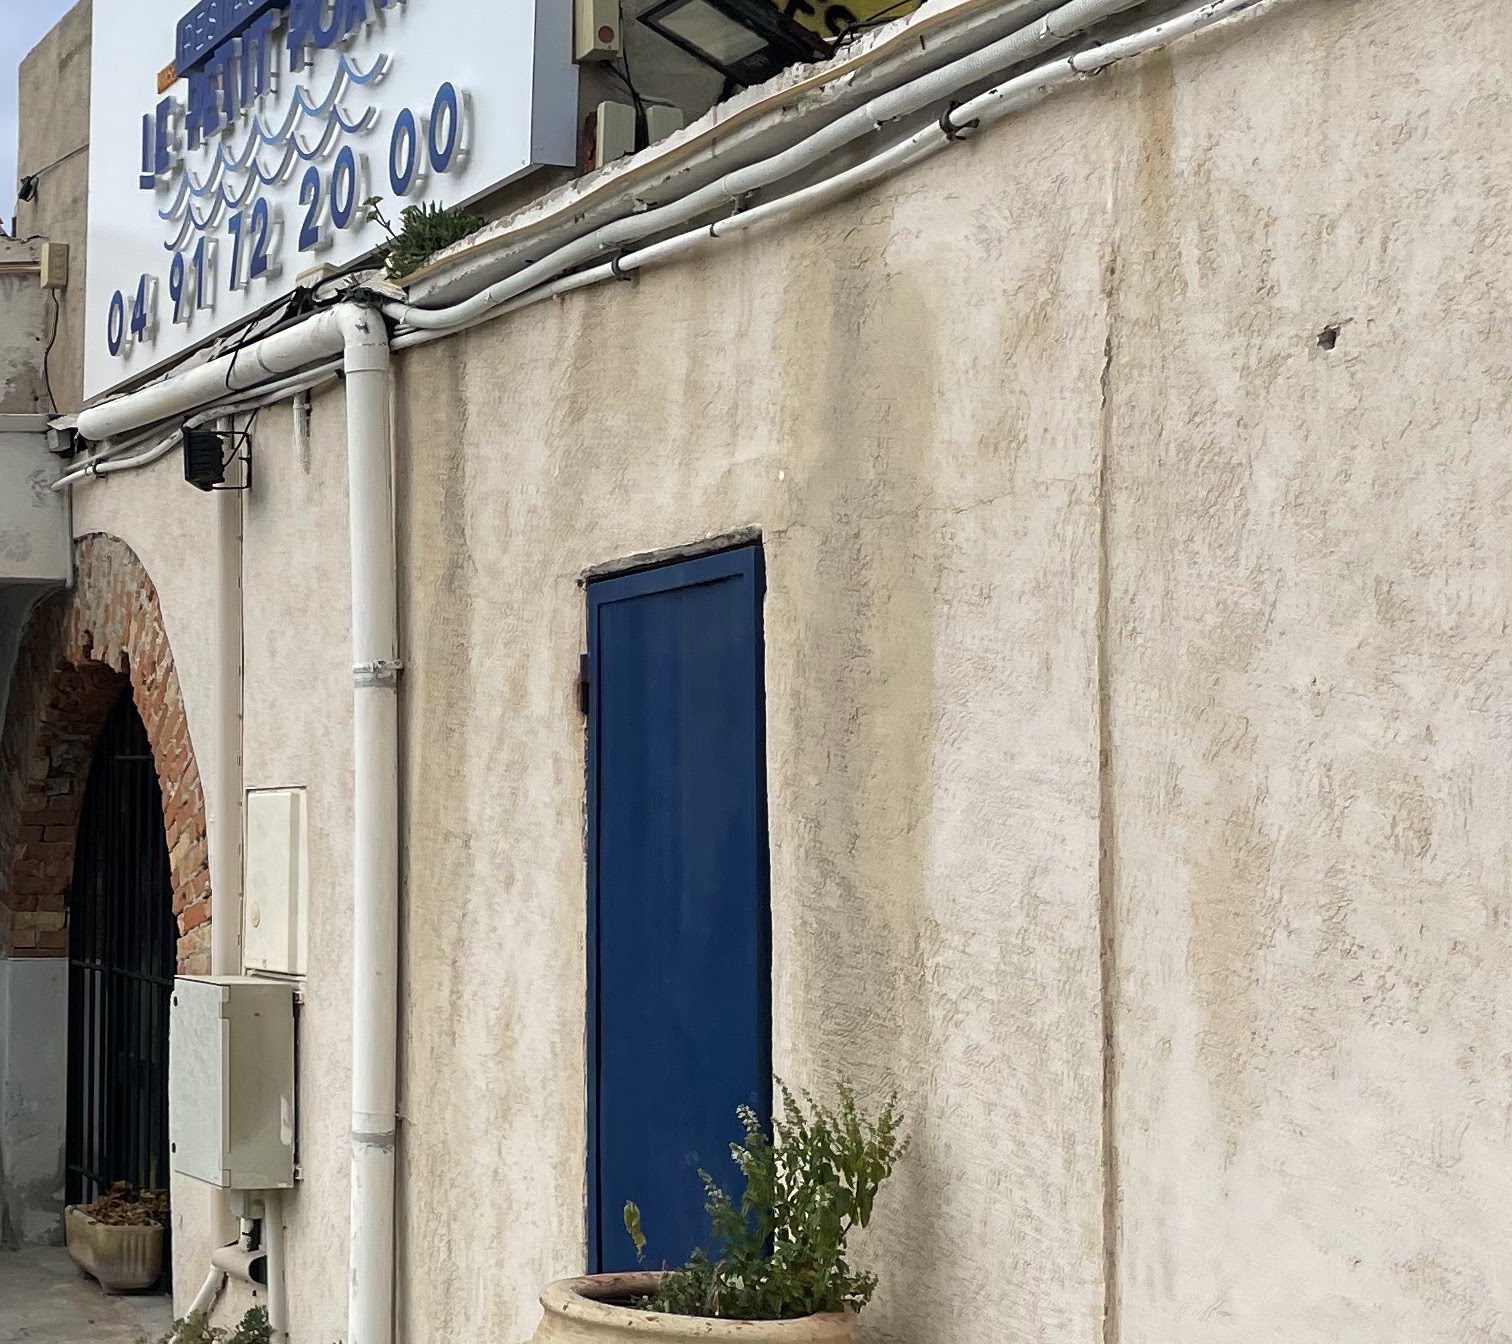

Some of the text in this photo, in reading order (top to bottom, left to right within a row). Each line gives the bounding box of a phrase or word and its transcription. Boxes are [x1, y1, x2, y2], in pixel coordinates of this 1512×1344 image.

[139, 96, 175, 189] LE
[185, 9, 276, 151] PETIT
[107, 273, 150, 356] 04
[170, 235, 210, 324] 91
[298, 145, 356, 252] 20
[389, 81, 459, 196] 00
